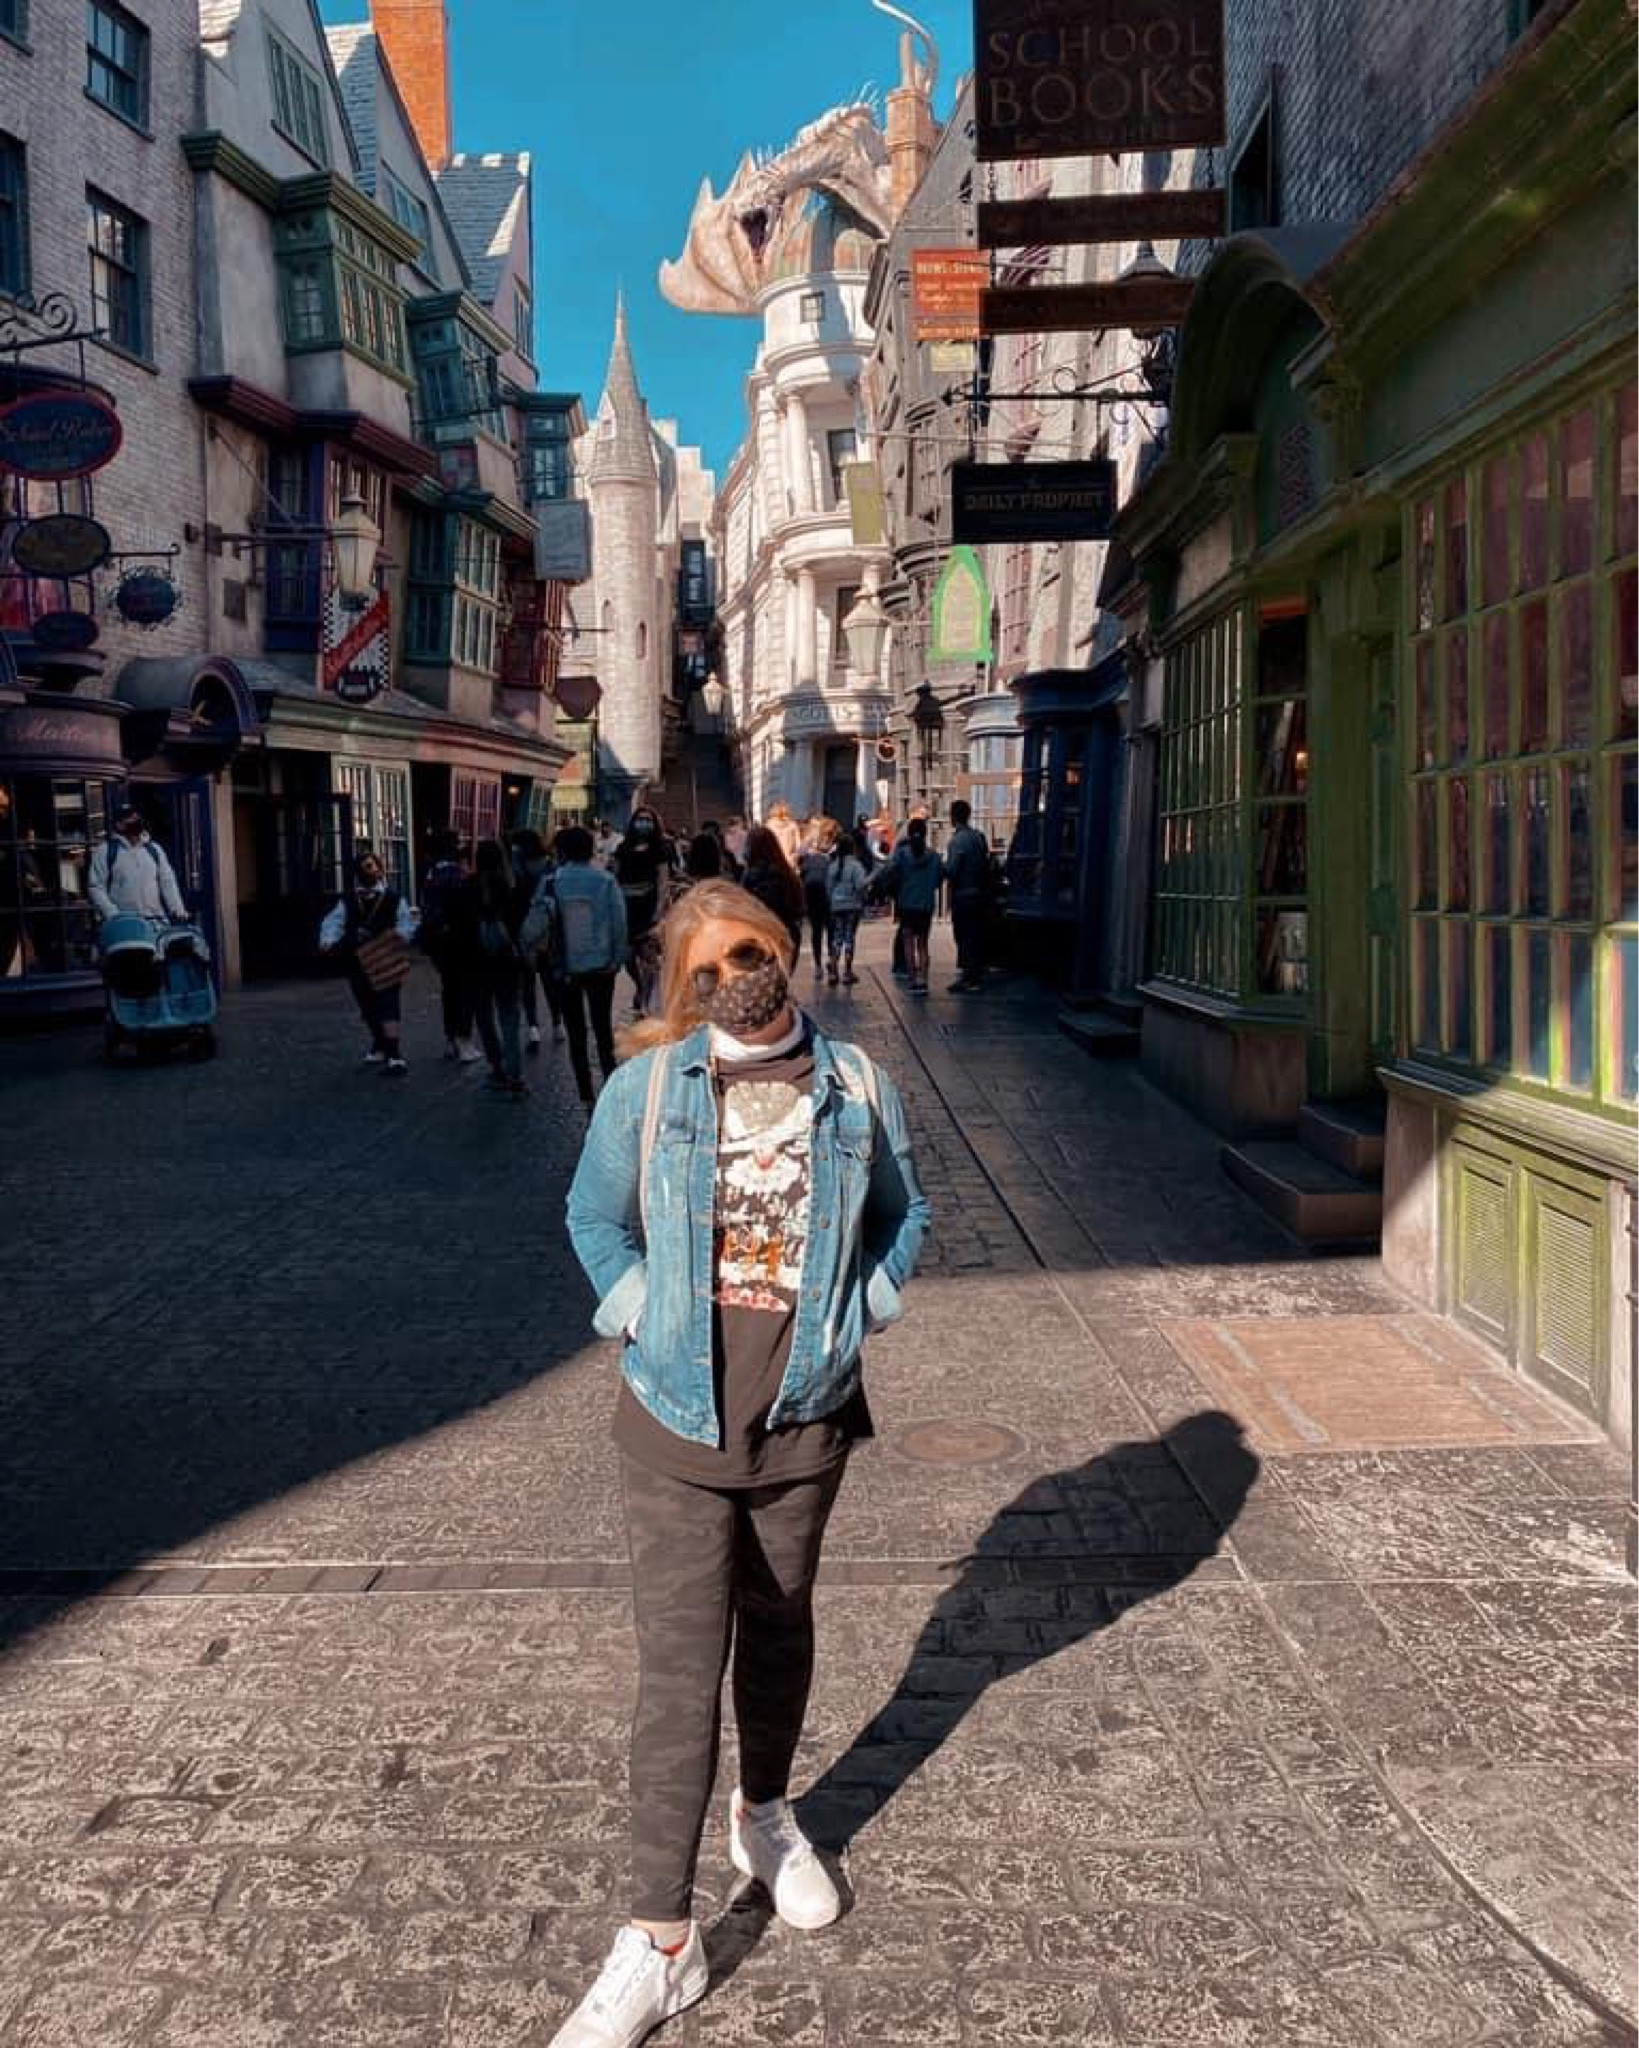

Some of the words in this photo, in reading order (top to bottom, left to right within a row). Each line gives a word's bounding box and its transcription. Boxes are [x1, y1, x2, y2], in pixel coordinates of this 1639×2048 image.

[989, 19, 1212, 69] SCHOOL
[989, 63, 1216, 128] BOOKS
[965, 494, 1015, 511] DAILY
[1020, 491, 1105, 509] PROPHET
